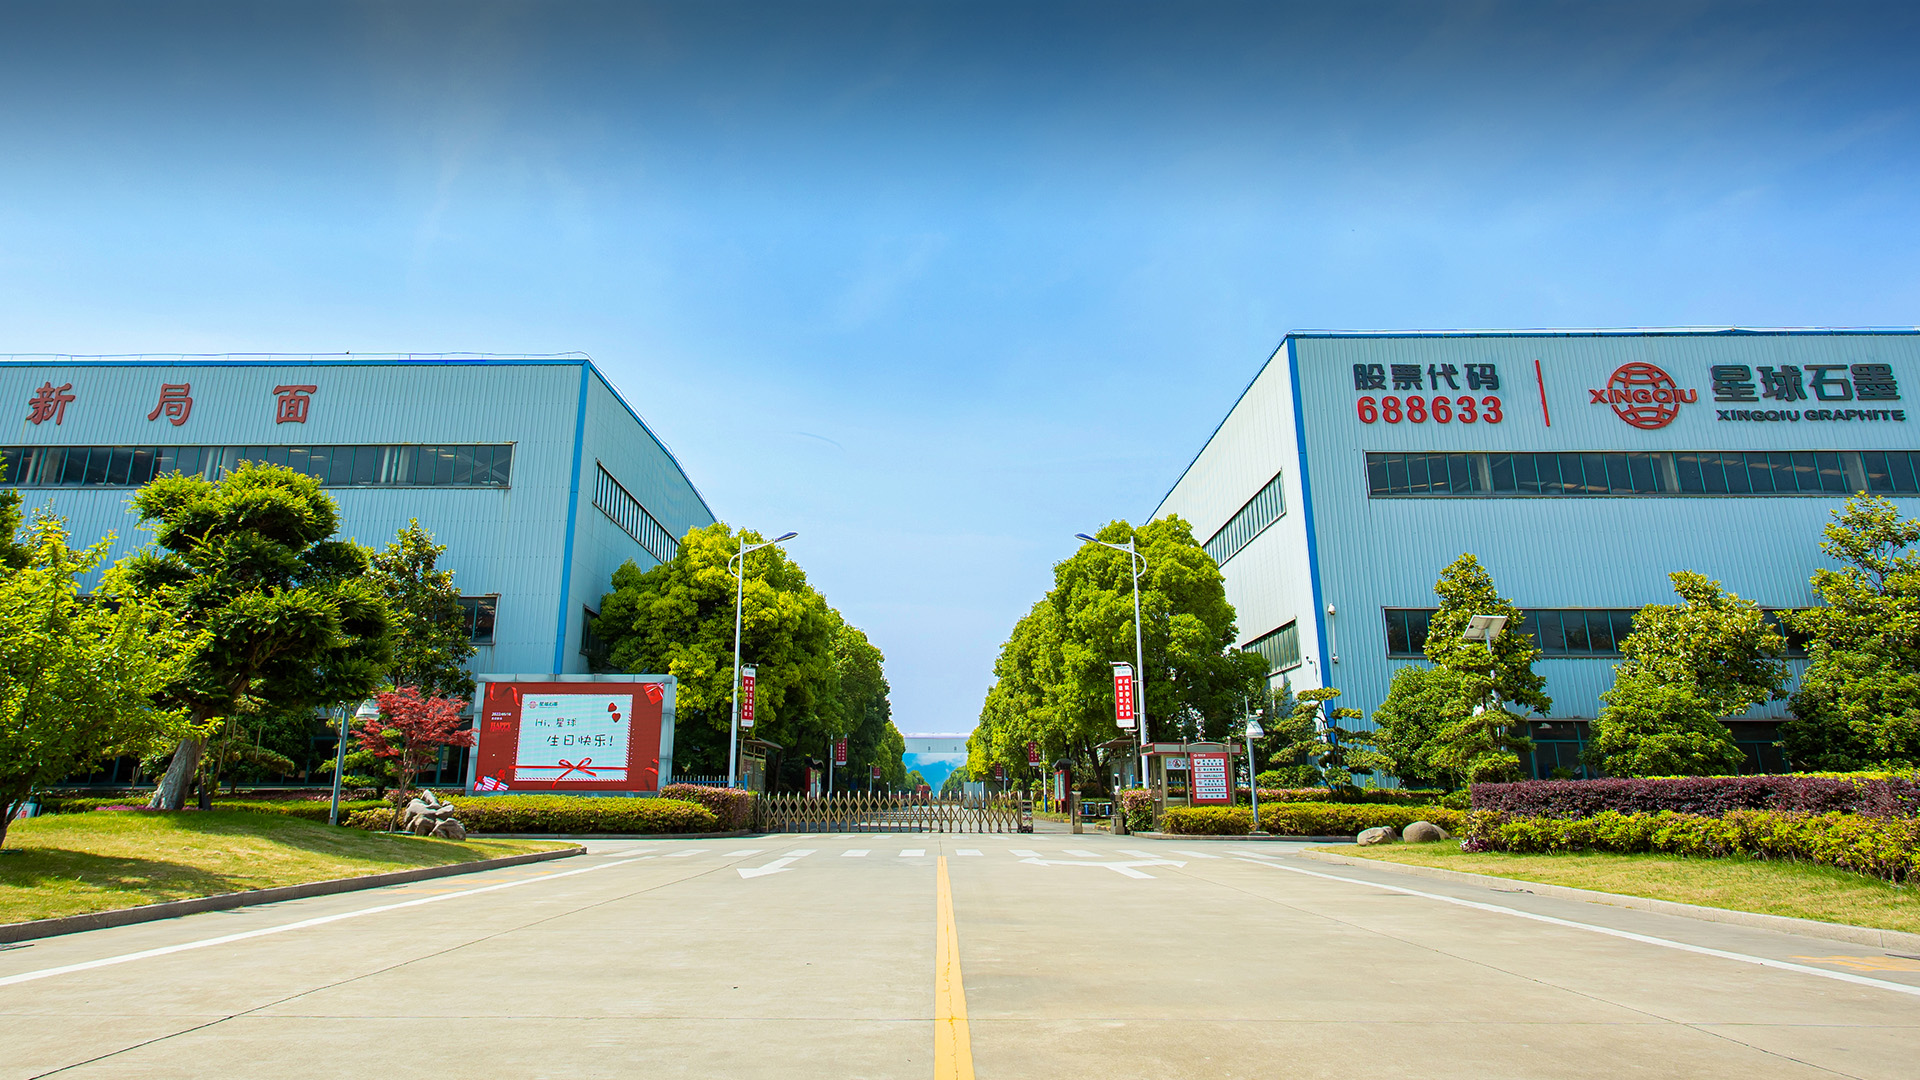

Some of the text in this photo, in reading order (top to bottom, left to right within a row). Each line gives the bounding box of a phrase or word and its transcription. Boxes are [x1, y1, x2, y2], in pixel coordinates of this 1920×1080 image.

[1353, 363, 1500, 391] 股票代码
[1711, 363, 1902, 402] 星球石墨
[25, 381, 318, 427] 新局面
[1357, 395, 1503, 424] 688633
[1588, 388, 1699, 404] XINGQIU
[1716, 409, 1906, 422] XINGQIU GRAPHITE
[556, 717, 577, 727] 星球
